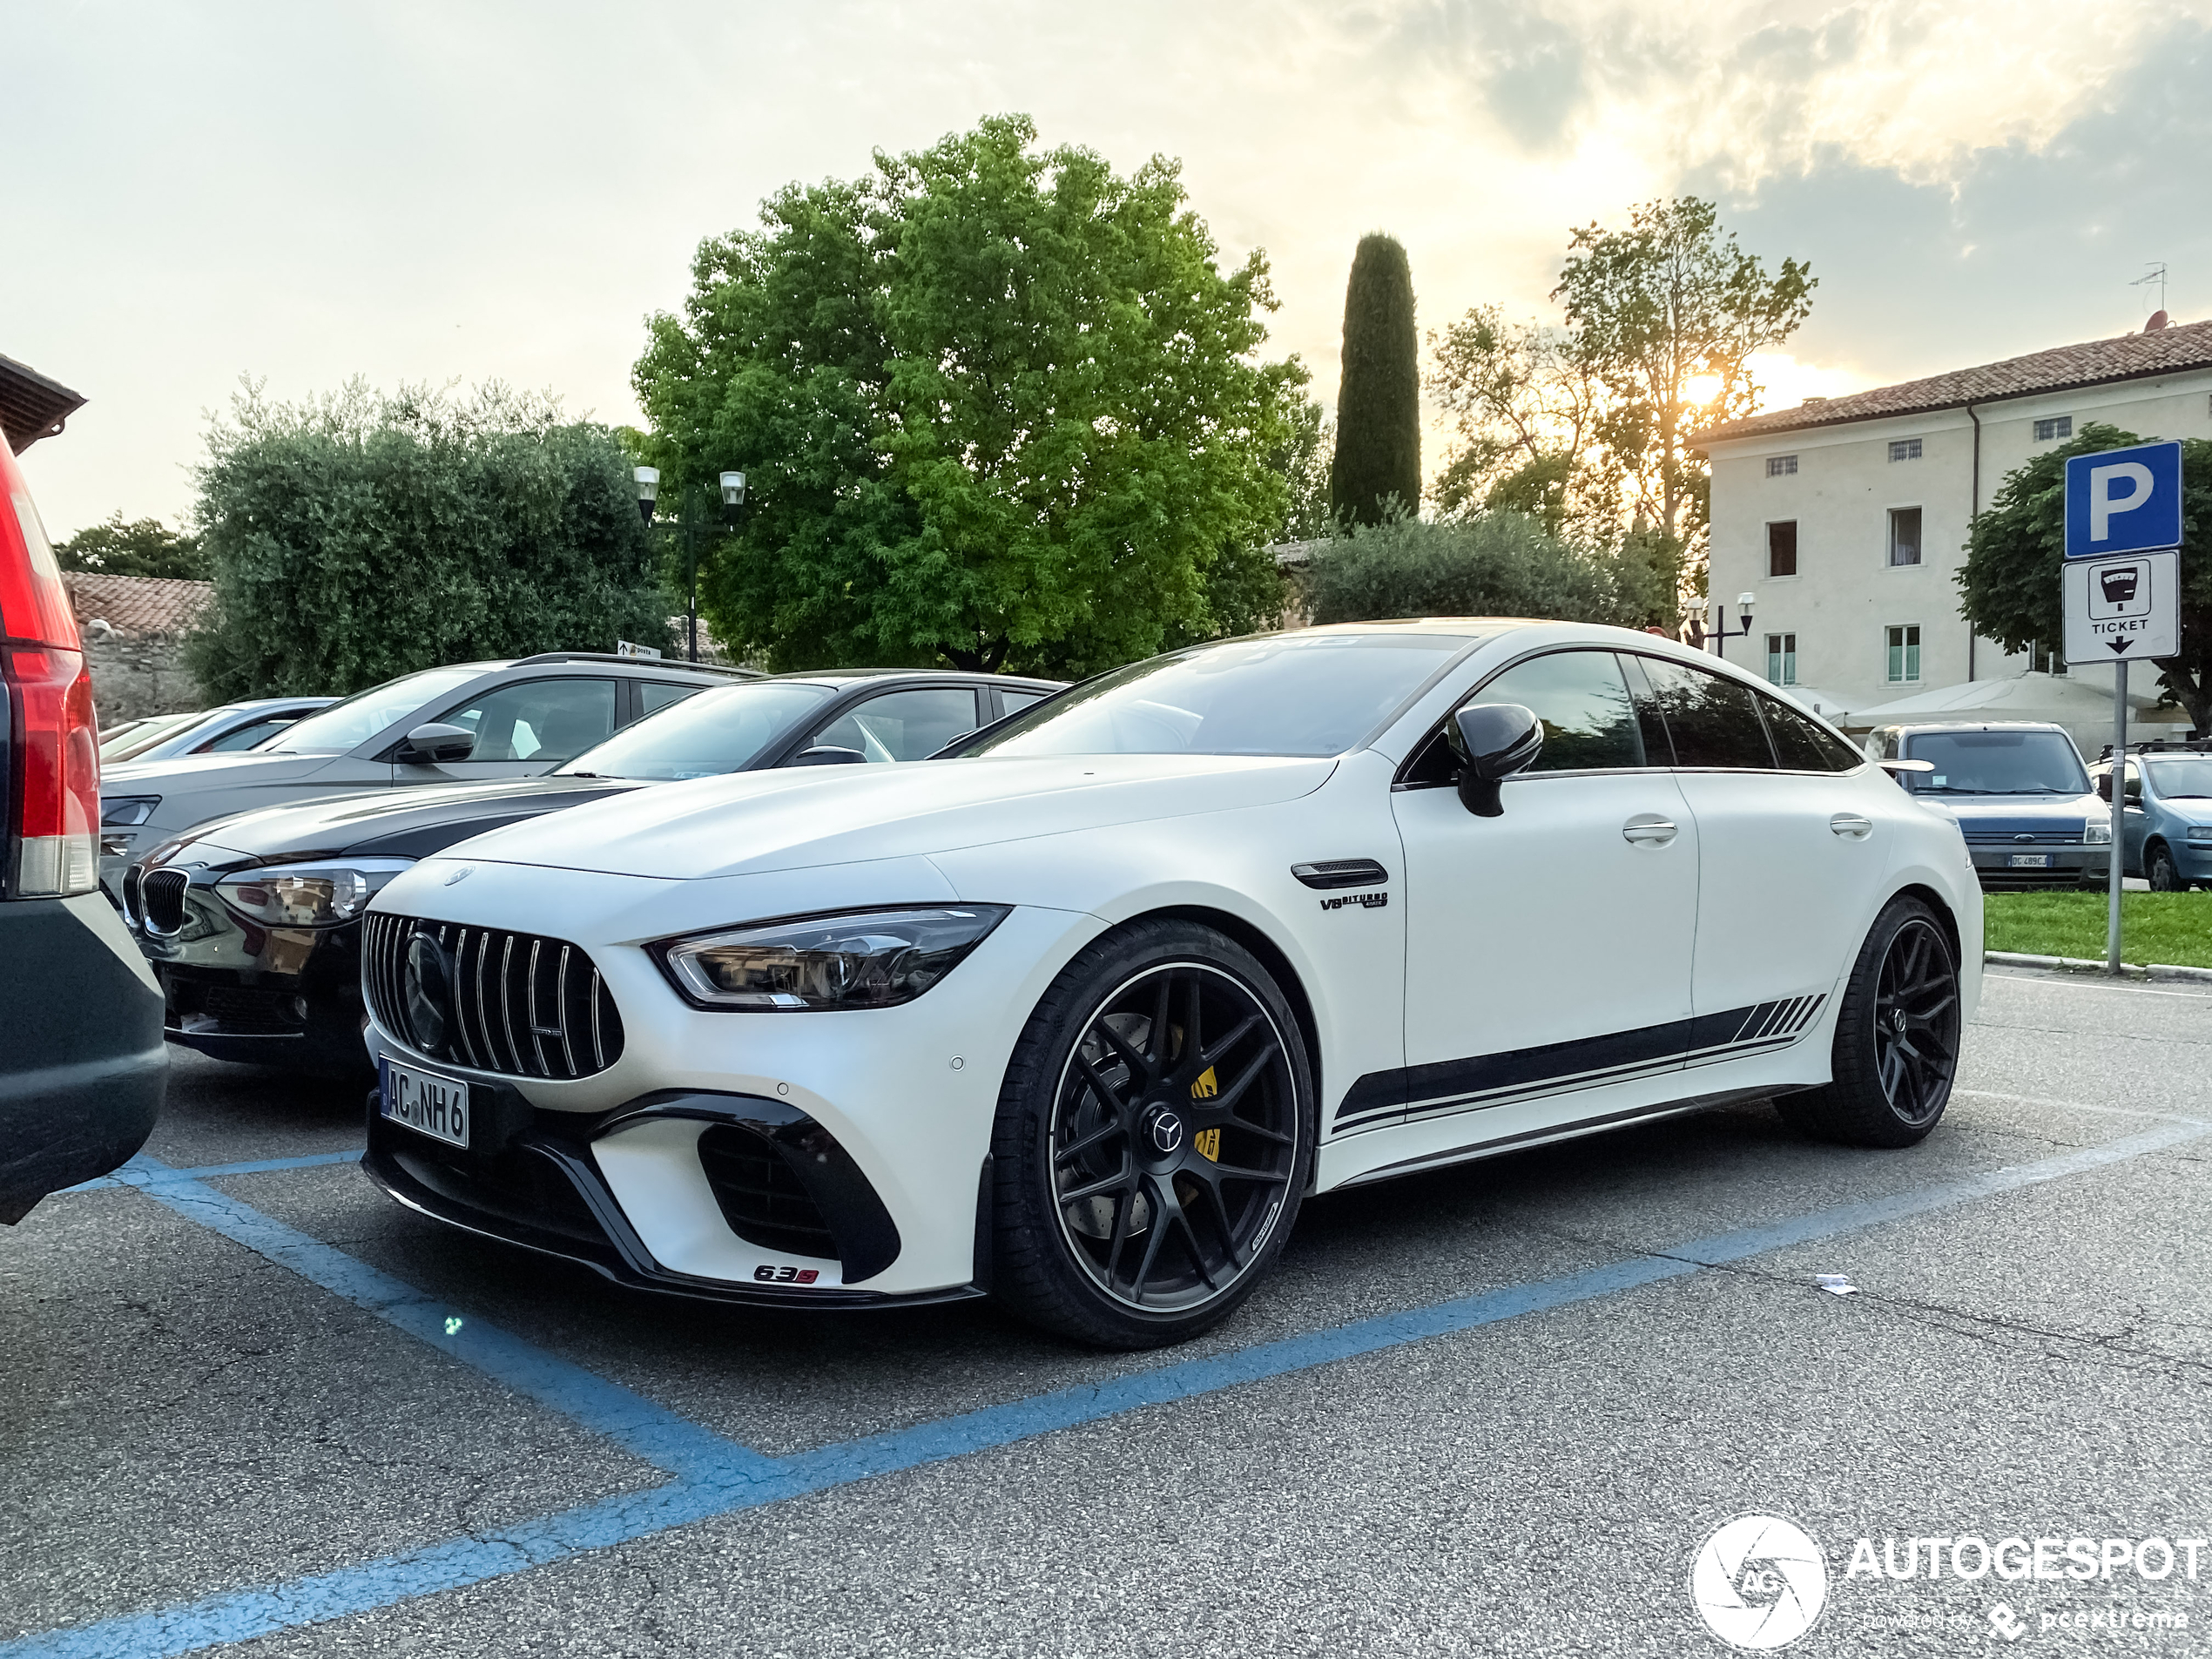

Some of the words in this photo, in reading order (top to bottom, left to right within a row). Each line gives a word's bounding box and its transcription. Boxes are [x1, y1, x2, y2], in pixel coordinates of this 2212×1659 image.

[2090, 462, 2155, 542] P
[2092, 619, 2148, 634] TICKET
[1320, 898, 1342, 911] V8
[1342, 892, 1387, 904] BITURBO
[389, 1069, 410, 1119] AC
[420, 1079, 447, 1134] NH
[450, 1089, 464, 1137] 6
